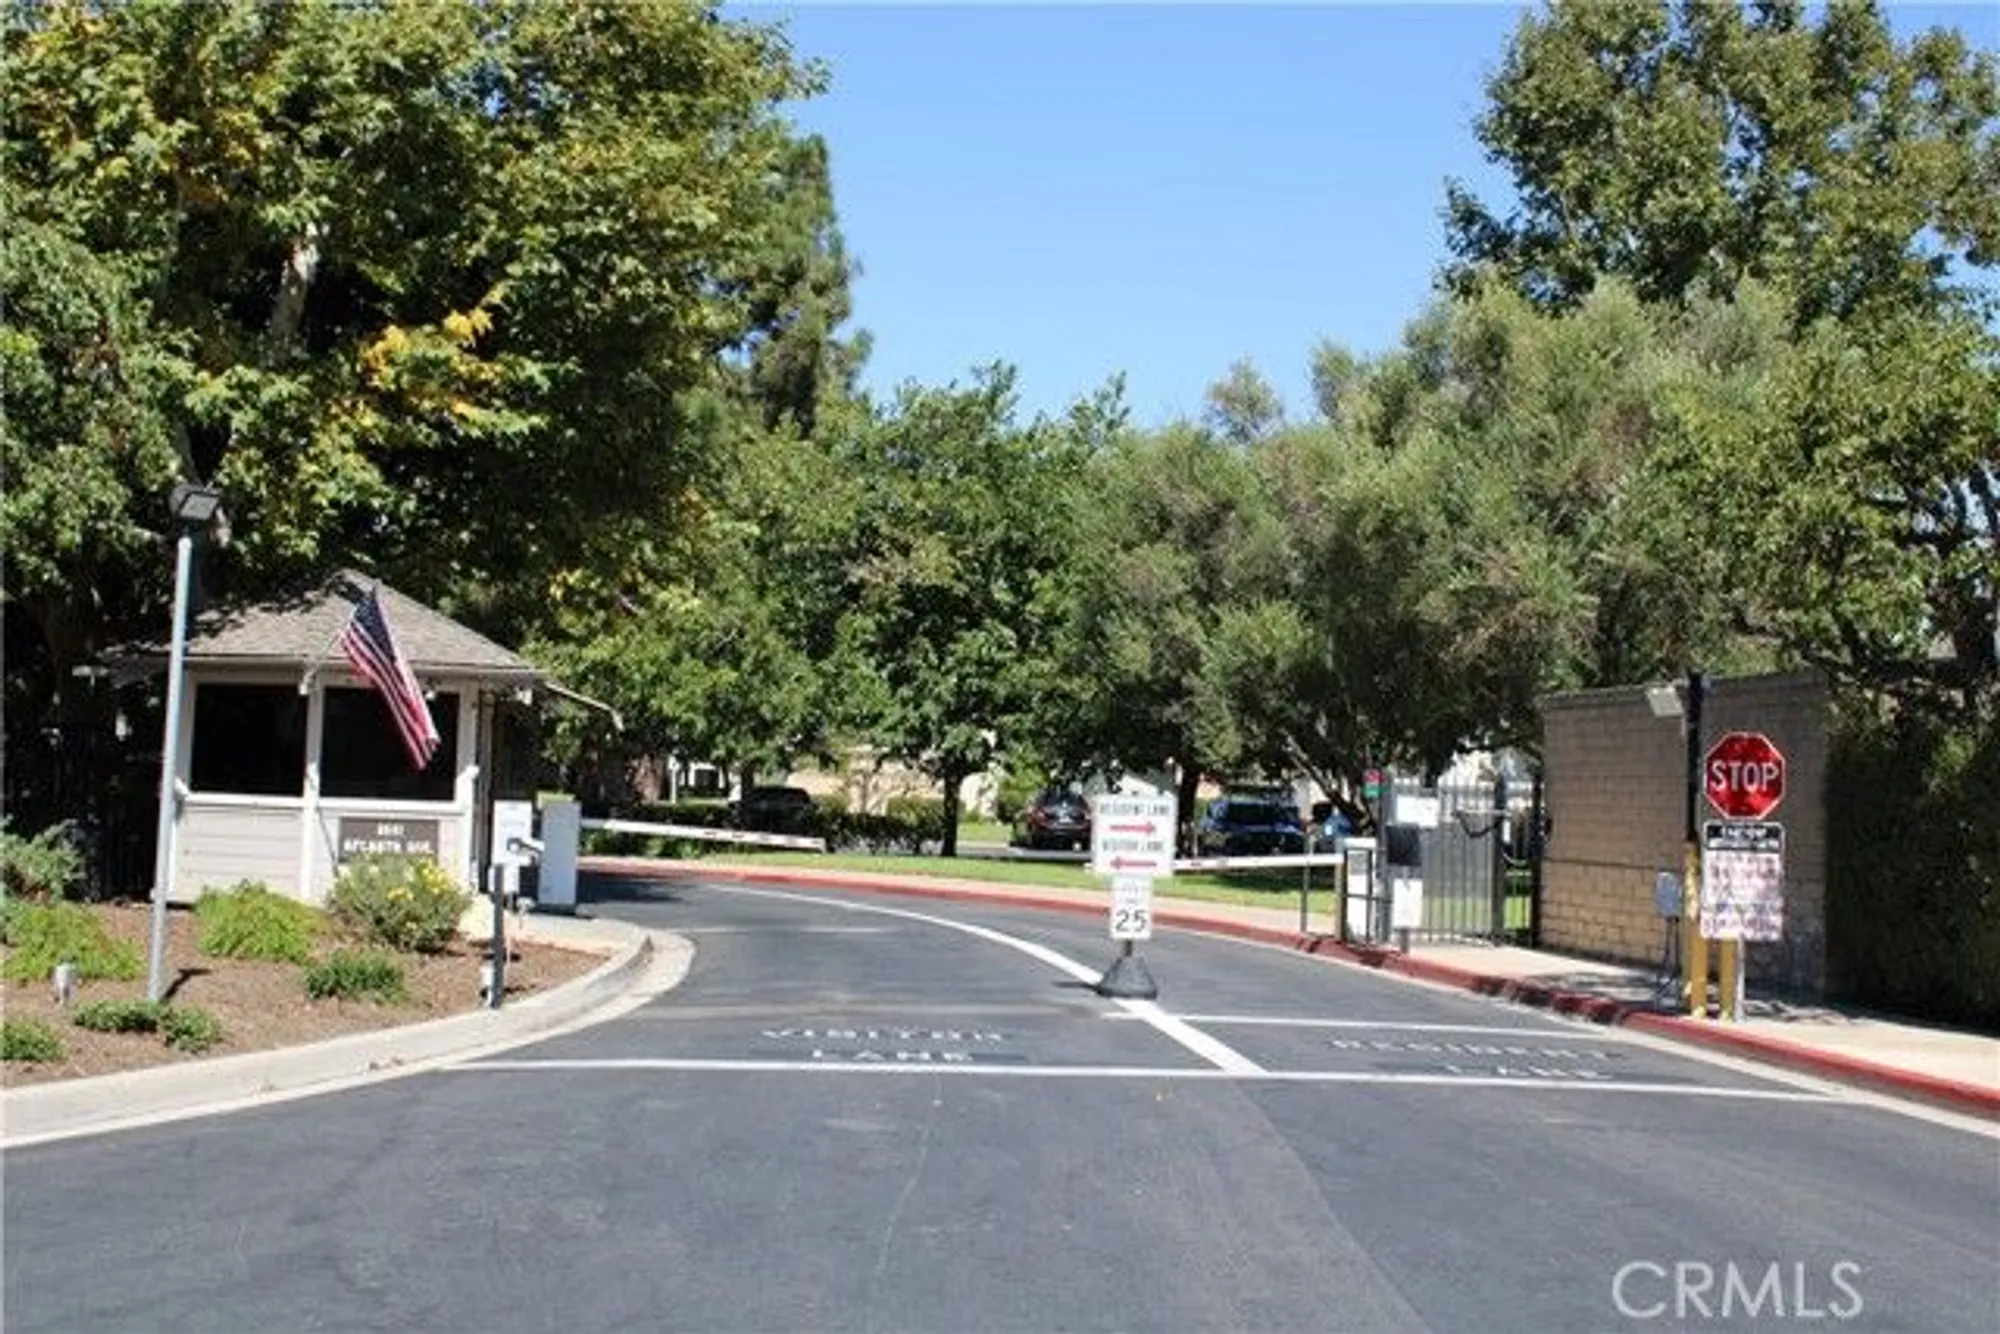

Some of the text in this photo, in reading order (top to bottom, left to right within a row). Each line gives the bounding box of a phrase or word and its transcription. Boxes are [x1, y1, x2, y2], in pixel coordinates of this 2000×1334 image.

[1710, 760, 1780, 792] STOP
[1115, 908, 1147, 932] 25
[761, 1028, 1002, 1043] VISITOR
[811, 1048, 974, 1062] LANE
